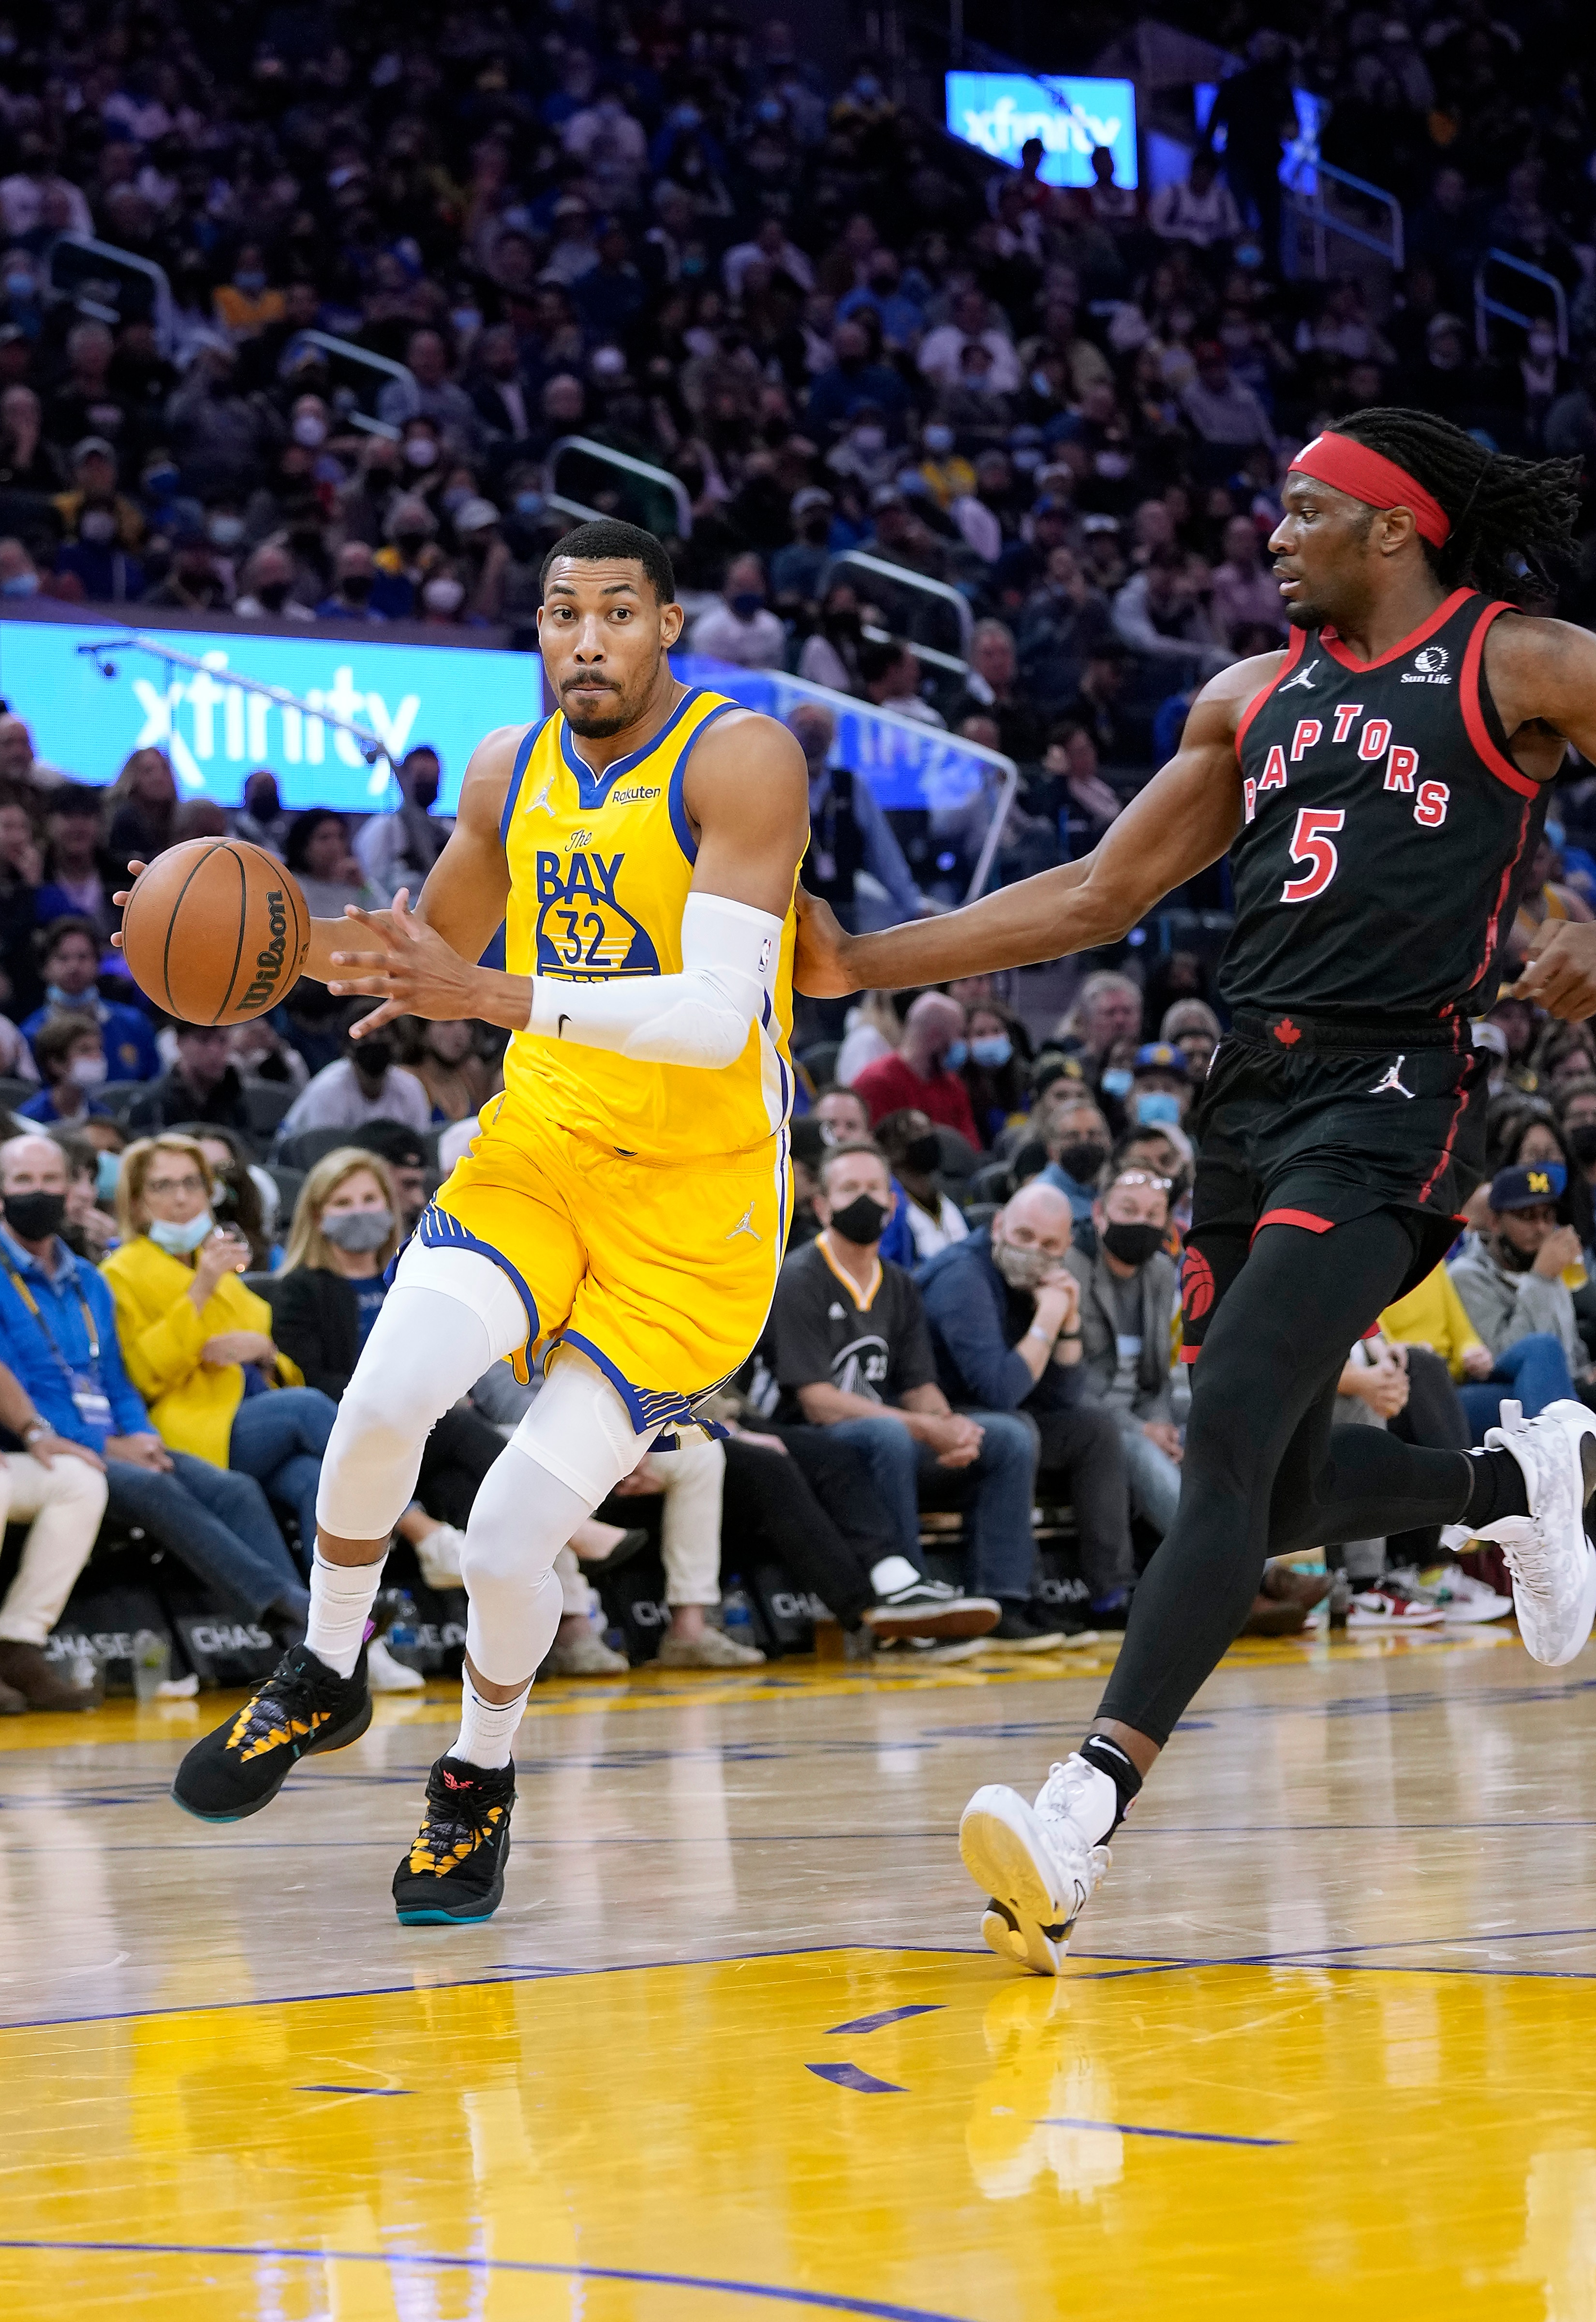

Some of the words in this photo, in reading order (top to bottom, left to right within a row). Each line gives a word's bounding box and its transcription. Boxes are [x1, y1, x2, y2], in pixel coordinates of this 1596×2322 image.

[1401, 673, 1425, 683] Sun
[1426, 674, 1452, 685] Life
[134, 651, 420, 795] xfinity
[1243, 704, 1450, 827] RAPTORS
[612, 786, 661, 804] Rakuten
[564, 829, 592, 852] The
[1280, 808, 1345, 903] 5
[536, 851, 625, 906] BAY
[235, 890, 287, 1010] Wilson
[556, 910, 611, 966] 32
[1526, 1172, 1550, 1193] M
[772, 1592, 837, 1618] CHA
[1039, 1578, 1089, 1604] CHA
[192, 1624, 273, 1652] CHAS
